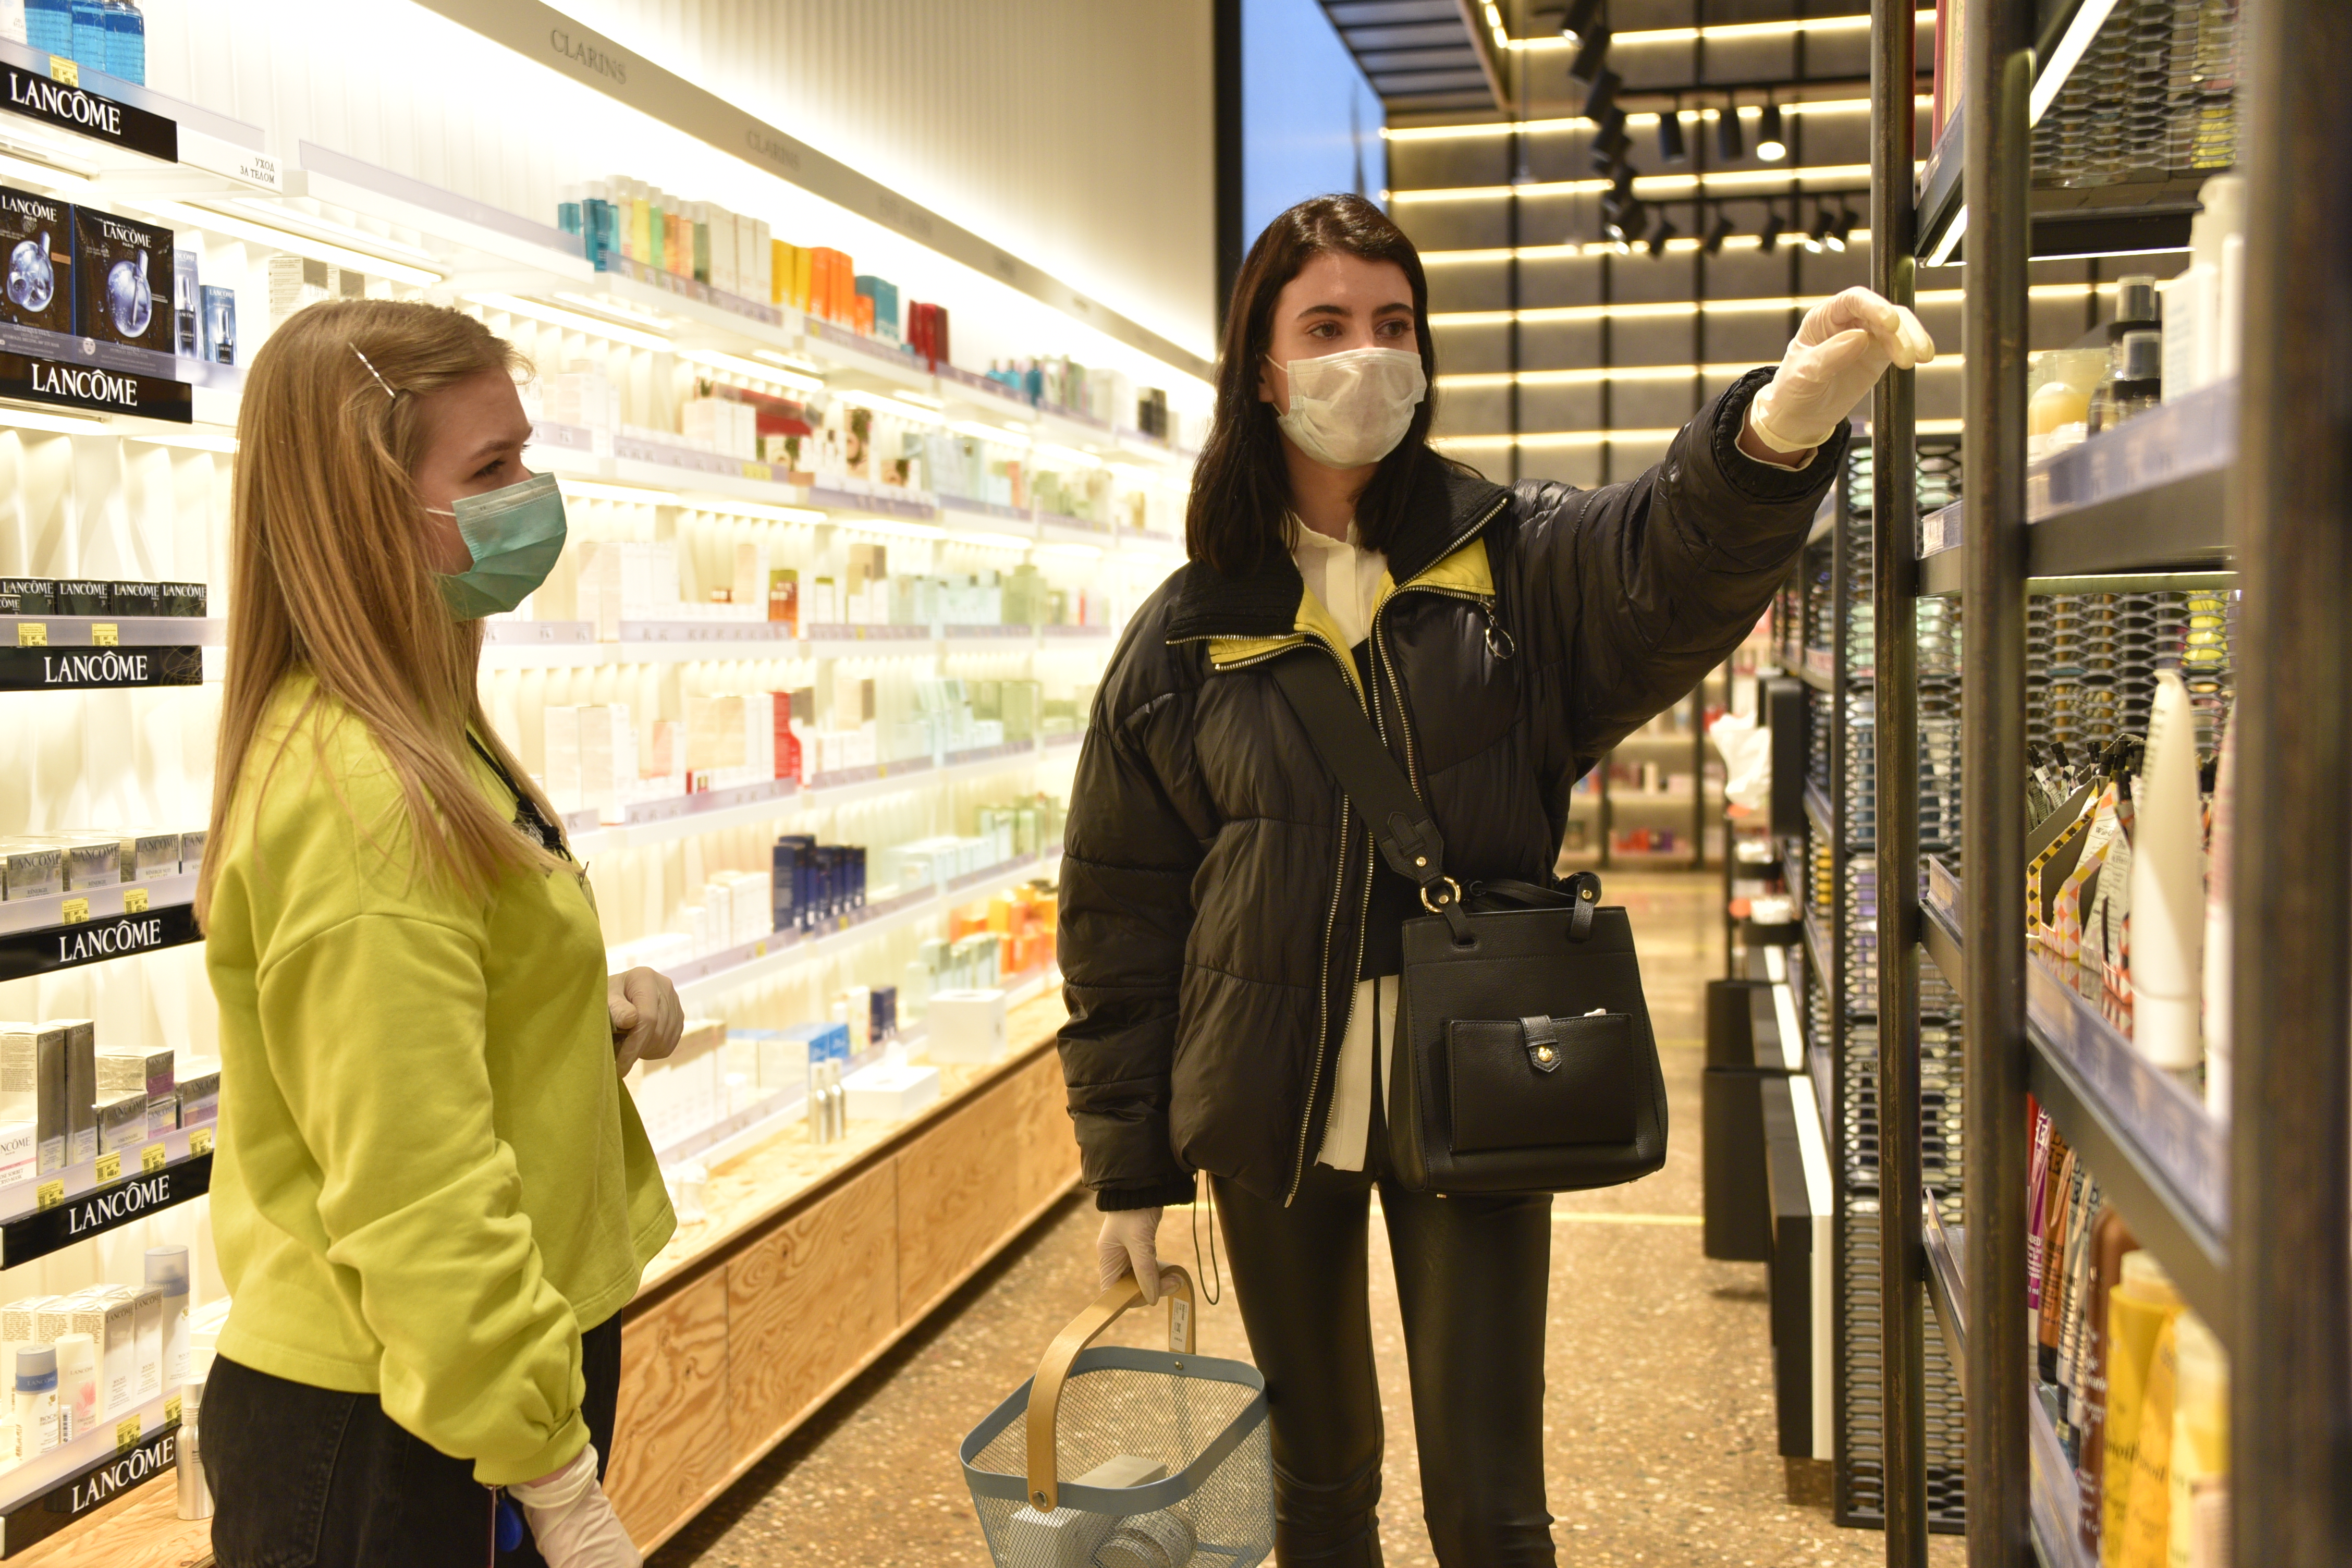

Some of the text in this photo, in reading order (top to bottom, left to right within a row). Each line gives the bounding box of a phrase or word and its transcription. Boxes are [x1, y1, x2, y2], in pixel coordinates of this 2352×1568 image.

[550, 30, 627, 85] CLARINS
[9, 71, 121, 136] LANCÔME
[240, 165, 275, 184] ЗА ТЕЛОМ
[255, 157, 275, 173] УХОД
[2, 194, 57, 223] LANCÔME
[103, 224, 152, 248] LANCÔME
[31, 363, 138, 407] LANCÔME
[3, 580, 54, 594] LANCÔME
[59, 582, 108, 595] LANCÔME
[114, 583, 160, 597] LANCÔME
[163, 584, 207, 598] LANCÔME
[44, 651, 148, 683] LANCÔME
[71, 845, 119, 863] LANCÔME
[136, 837, 178, 853] LANCÔME
[9, 852, 62, 871] LANCÔME
[59, 919, 161, 963] LANCÔME
[69, 1174, 170, 1235] LANCÔME
[71, 1436, 174, 1514] LANCÔME
